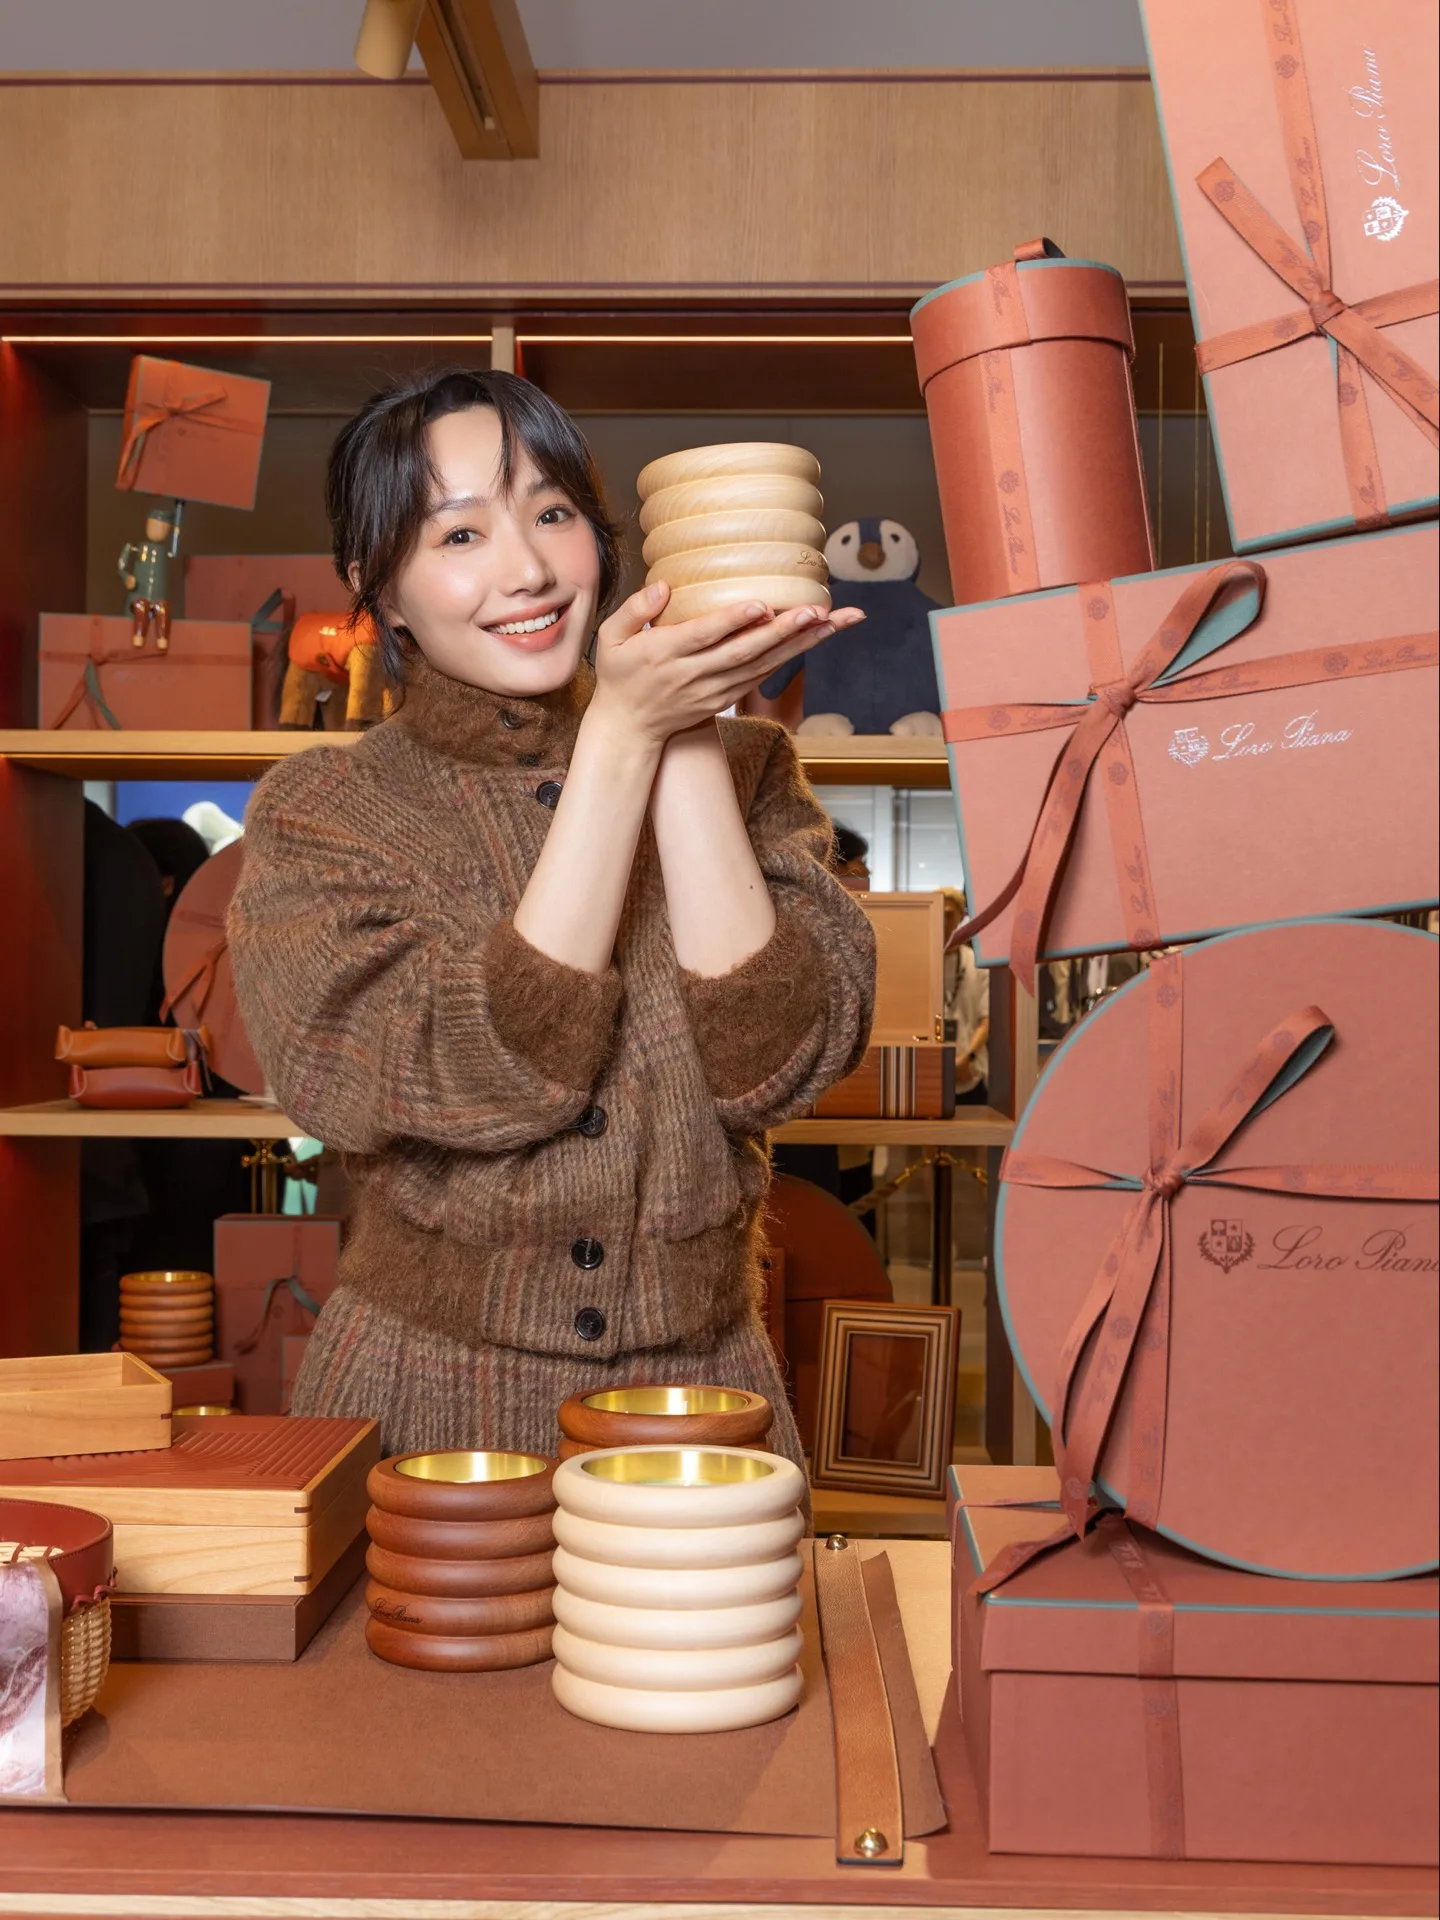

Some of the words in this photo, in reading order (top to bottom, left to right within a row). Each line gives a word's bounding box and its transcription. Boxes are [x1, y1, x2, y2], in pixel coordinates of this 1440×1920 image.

[1346, 46, 1386, 121] Piana
[1356, 125, 1400, 191] Loro
[1212, 722, 1276, 761] Loro
[1281, 709, 1354, 750] Piana
[1257, 1225, 1349, 1271] Loro
[392, 1601, 423, 1624] Piana
